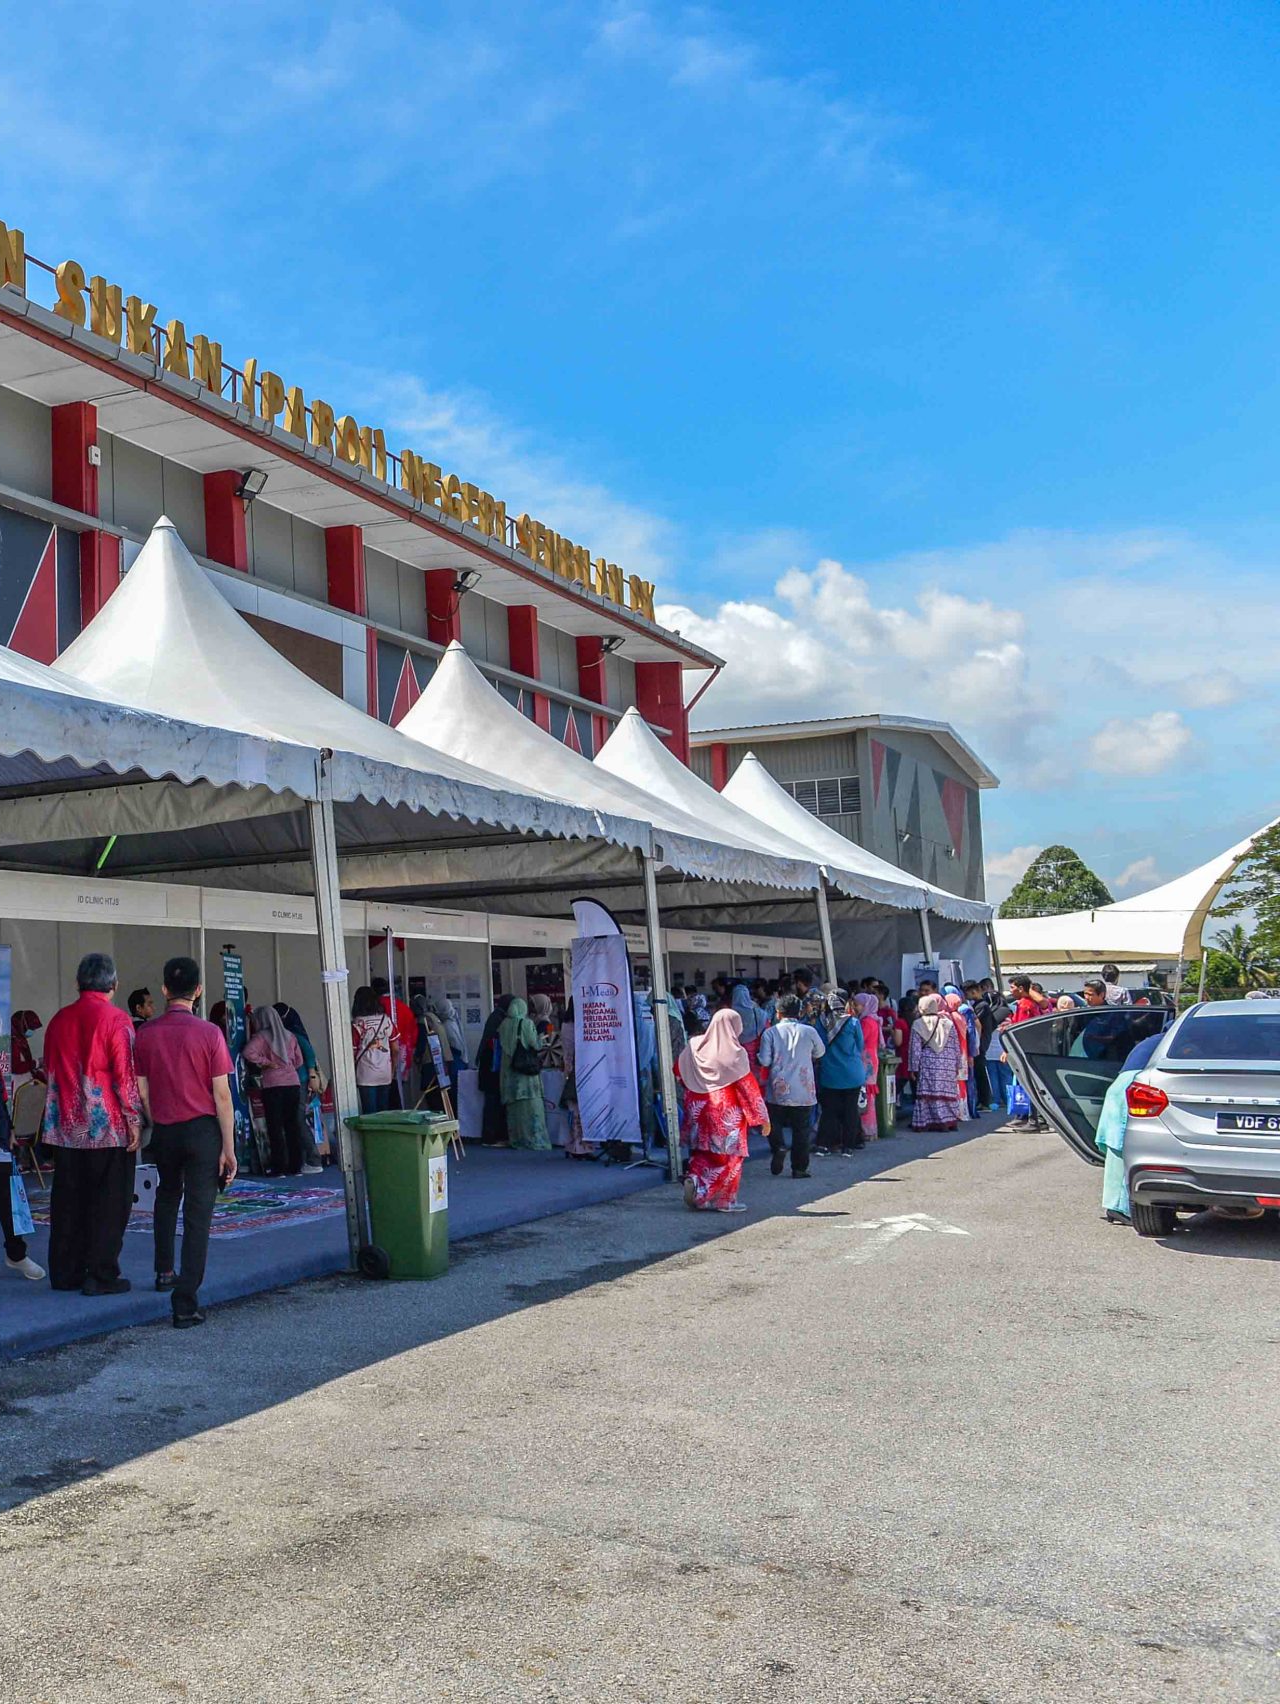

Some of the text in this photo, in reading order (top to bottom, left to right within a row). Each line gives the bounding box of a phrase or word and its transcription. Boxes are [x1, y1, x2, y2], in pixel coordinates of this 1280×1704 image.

[53, 260, 222, 396] SUKAN
[400, 449, 507, 545] NEGERI
[1236, 1115, 1264, 1129] VDF
